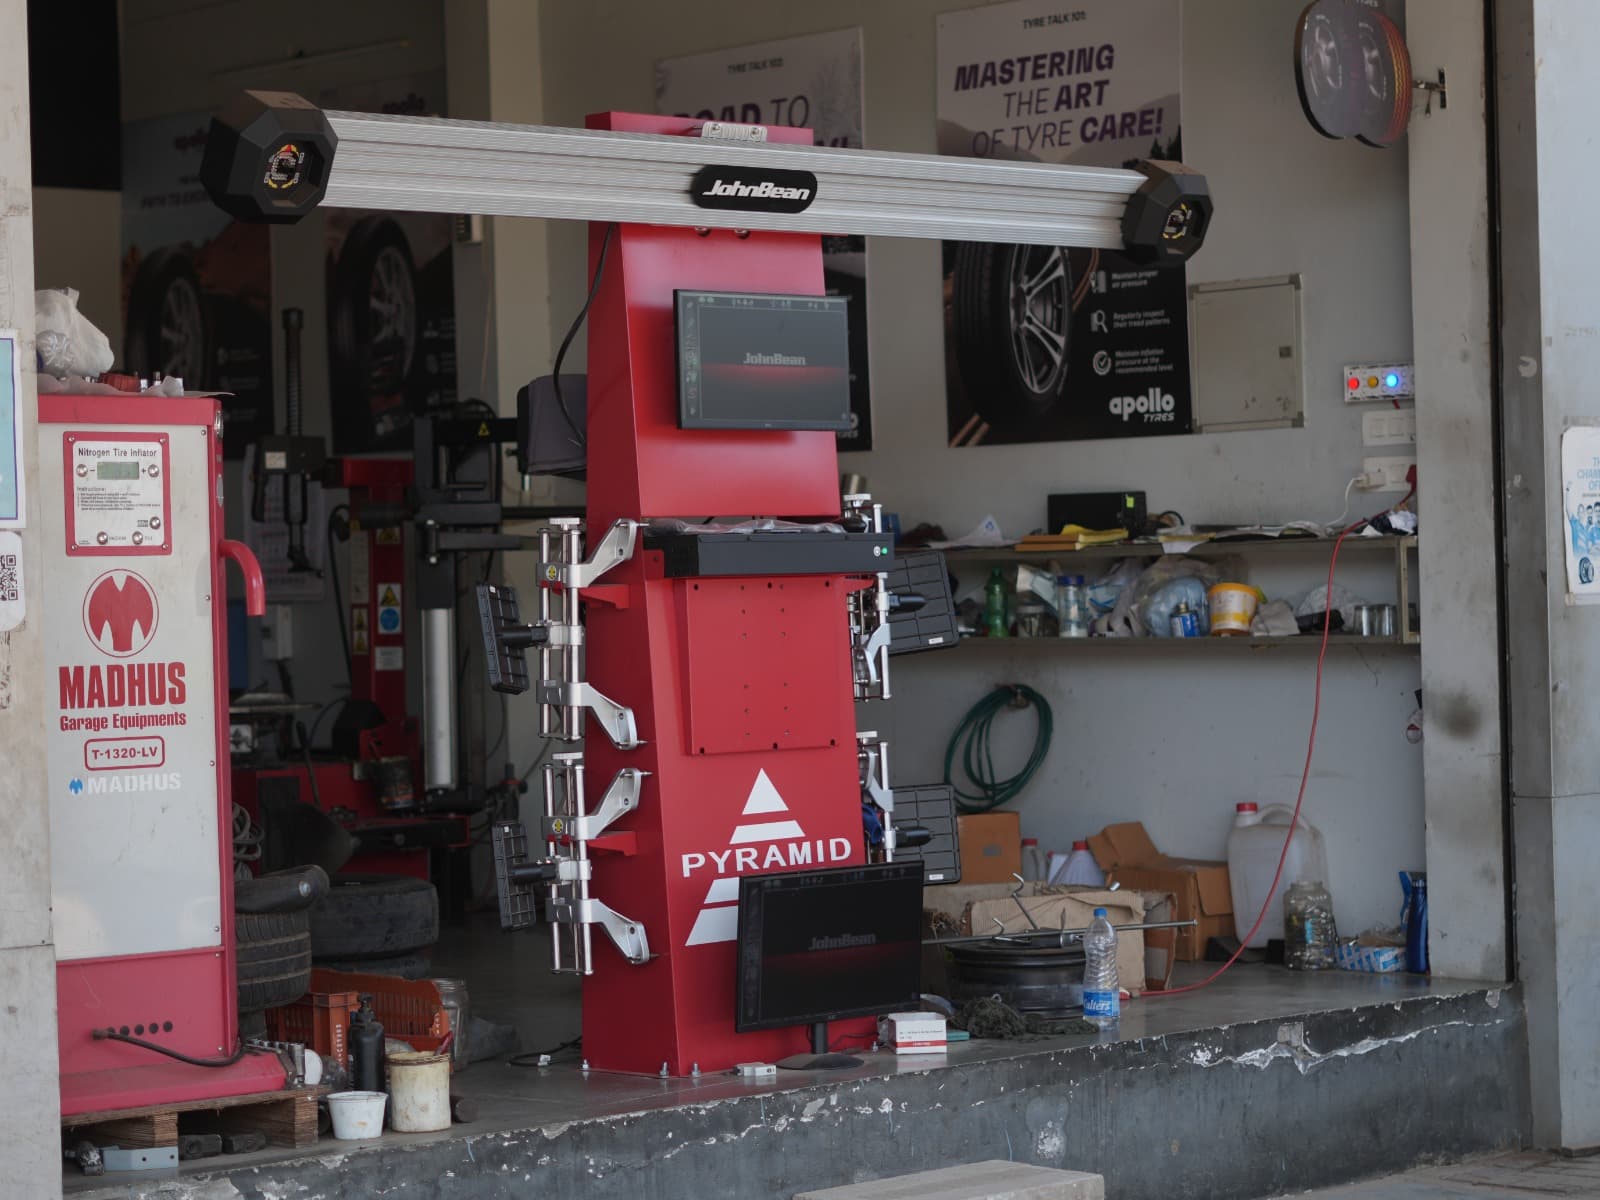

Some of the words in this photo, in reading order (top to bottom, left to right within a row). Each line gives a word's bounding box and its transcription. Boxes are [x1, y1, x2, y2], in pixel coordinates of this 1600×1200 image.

[1023, 17, 1045, 29] TYRE
[1047, 13, 1070, 24] TALK
[954, 44, 1115, 92] MASTERING
[1003, 88, 1050, 118] THE
[1054, 80, 1110, 112] ART
[770, 95, 810, 128] TO
[972, 129, 1004, 157] OF
[1011, 120, 1073, 152] TYRE
[1080, 108, 1164, 144] CARE!
[702, 180, 810, 200] JohnBean
[743, 352, 807, 366] JohnBean
[1109, 387, 1175, 421] apollo
[1143, 412, 1175, 423] TYRES
[78, 448, 111, 459] Nitrogen
[113, 448, 128, 457] Tire
[130, 448, 157, 457] Inflator
[59, 662, 186, 709] MADHUS
[60, 715, 108, 731] Garage
[112, 712, 187, 730] Equipments
[92, 746, 158, 760] T-1320-LV
[87, 773, 181, 794] MADHUS
[681, 837, 852, 878] PYRAMID
[808, 933, 877, 951] JohnBean
